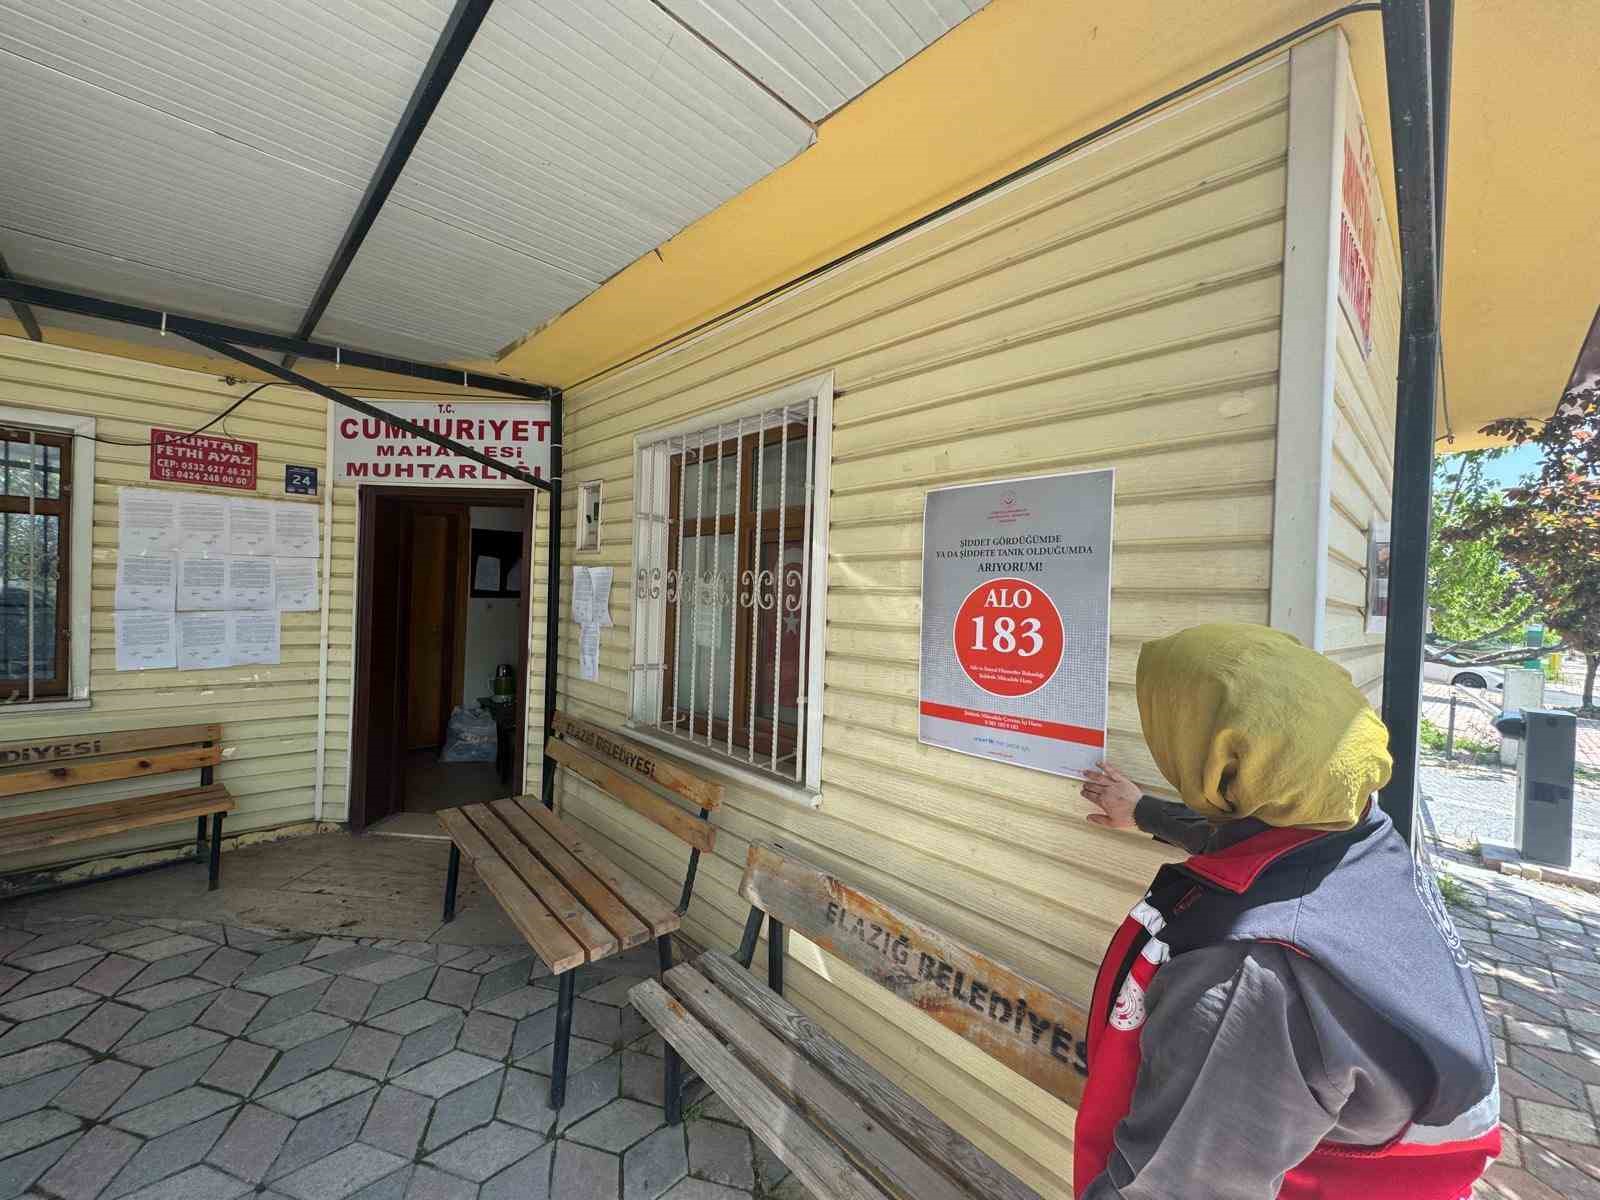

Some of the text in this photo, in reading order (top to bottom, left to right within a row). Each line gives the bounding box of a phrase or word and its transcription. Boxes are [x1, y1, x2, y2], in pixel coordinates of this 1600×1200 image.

[438, 404, 455, 414] T.C.
[165, 434, 244, 453] MUHTAR
[208, 451, 252, 465] AYAZ
[376, 445, 522, 458] MAHAESİ
[292, 474, 311, 486] 24
[978, 562, 1043, 572] ARIYORUM!
[984, 588, 1032, 609] ALO
[971, 615, 1044, 657] 183
